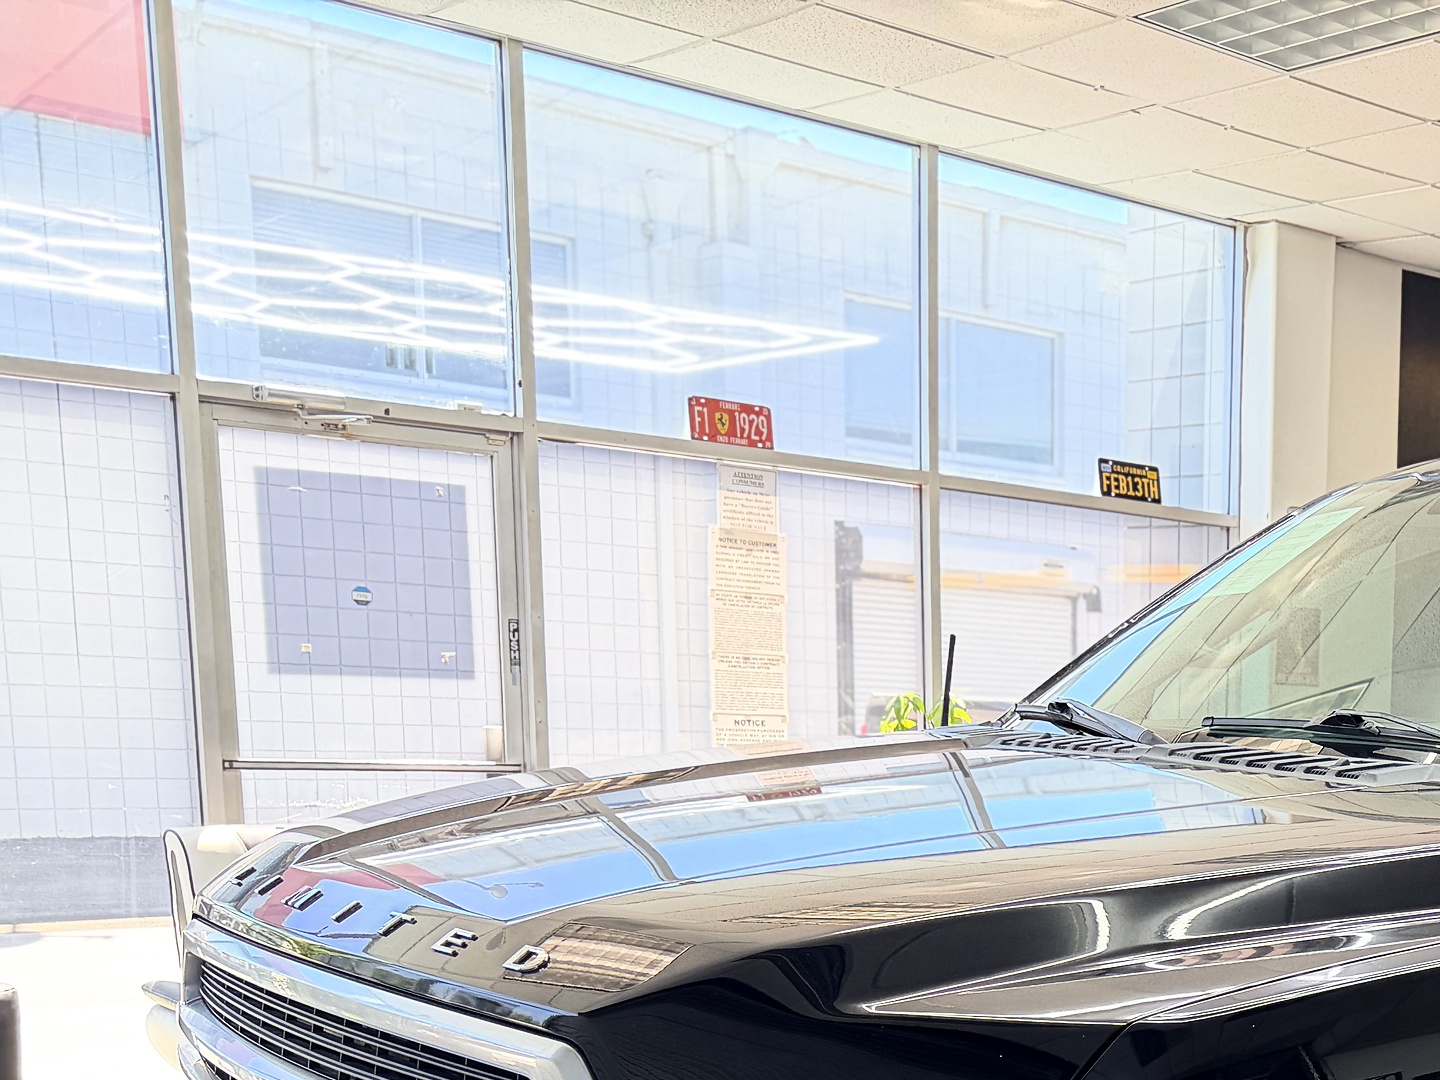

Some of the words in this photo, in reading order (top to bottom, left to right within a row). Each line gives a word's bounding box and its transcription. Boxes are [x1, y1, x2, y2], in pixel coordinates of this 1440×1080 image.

[694, 406, 709, 433] F1
[734, 411, 768, 441] 1929
[733, 471, 763, 480] ATTENTION
[1113, 464, 1147, 476] CALIFORNIA
[1102, 472, 1159, 500] FEB13TH
[718, 537, 737, 545] NOTICE
[748, 540, 778, 549] CUSTOMER
[509, 622, 519, 660] PUSH
[734, 719, 766, 727] NOTICE
[229, 866, 551, 974] LIMITED
